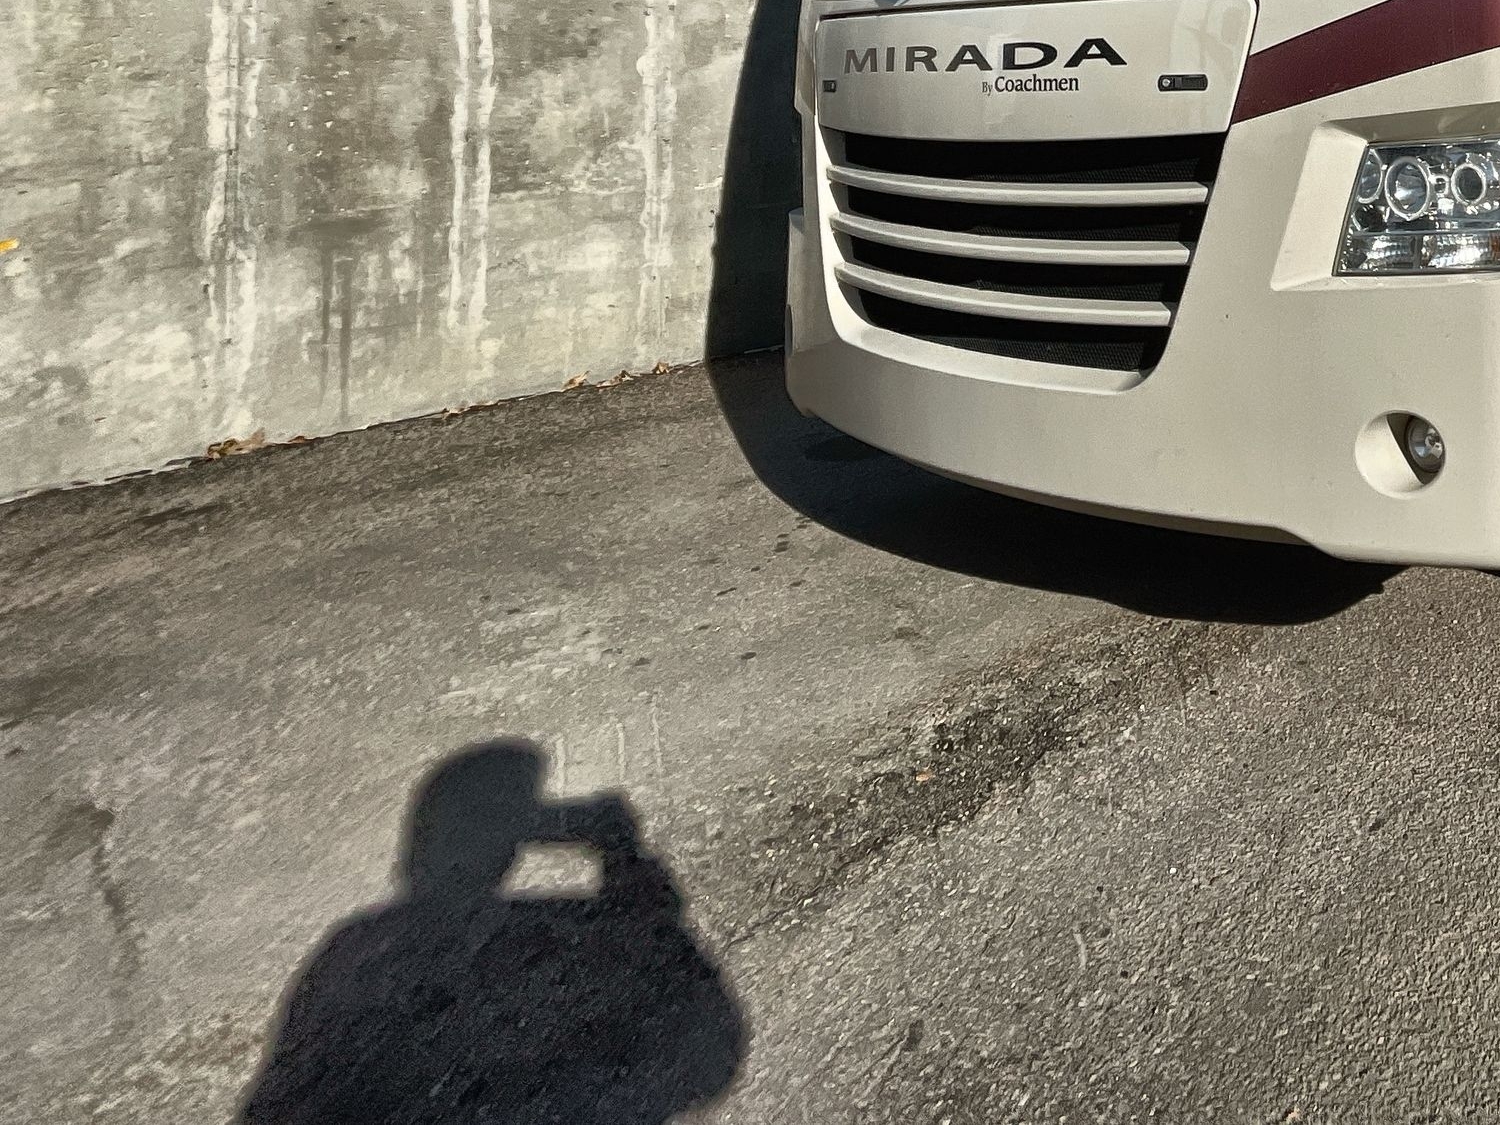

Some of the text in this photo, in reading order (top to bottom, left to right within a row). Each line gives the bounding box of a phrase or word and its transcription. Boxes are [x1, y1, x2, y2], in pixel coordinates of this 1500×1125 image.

[843, 37, 1127, 74] MIRADA
[981, 73, 1079, 96] By Coachmen
